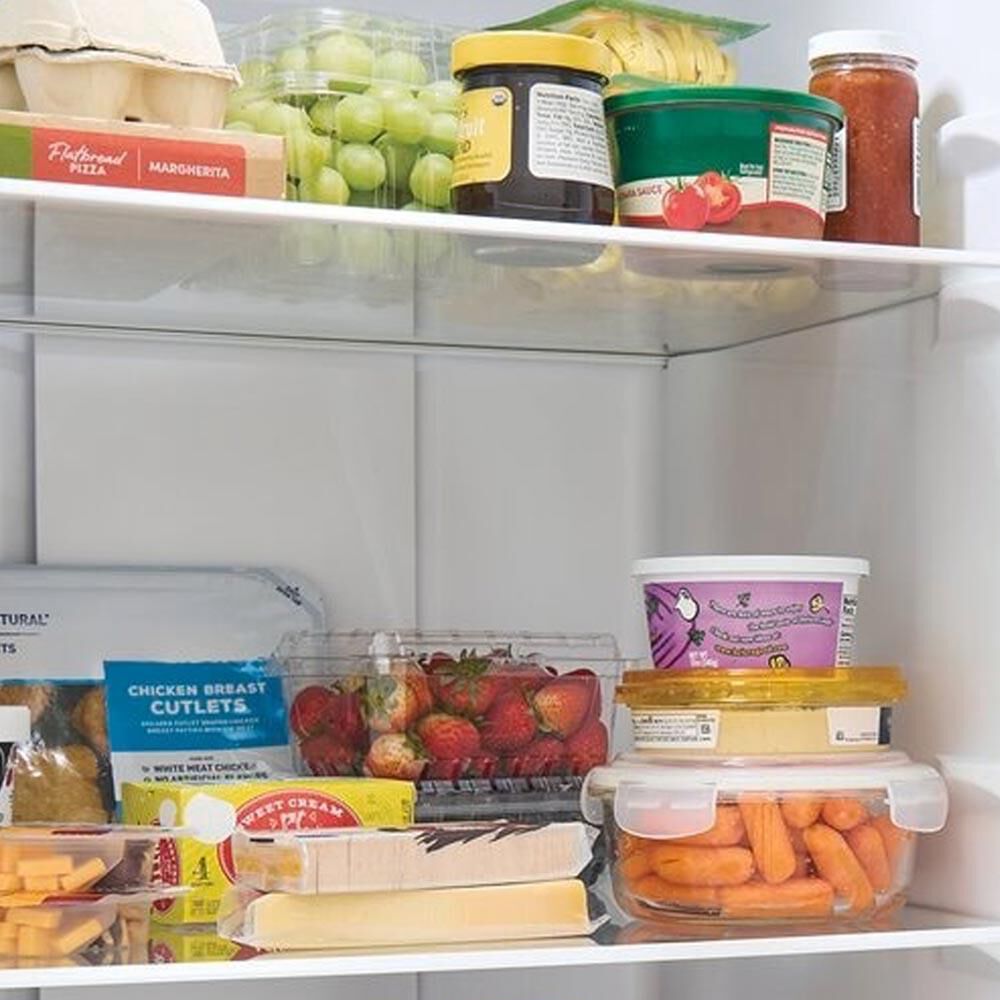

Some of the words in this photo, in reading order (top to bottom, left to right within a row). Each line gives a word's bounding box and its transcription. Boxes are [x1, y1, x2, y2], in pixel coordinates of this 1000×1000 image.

[70, 163, 107, 176] PIZZA
[149, 160, 230, 180] MARGHERITA
[128, 684, 198, 697] CHICKEN
[204, 682, 267, 696] BREAST
[151, 698, 248, 715] CUTLETS
[153, 764, 185, 774] WHITE
[186, 763, 213, 773] MEAT
[288, 798, 345, 819] CREAM
